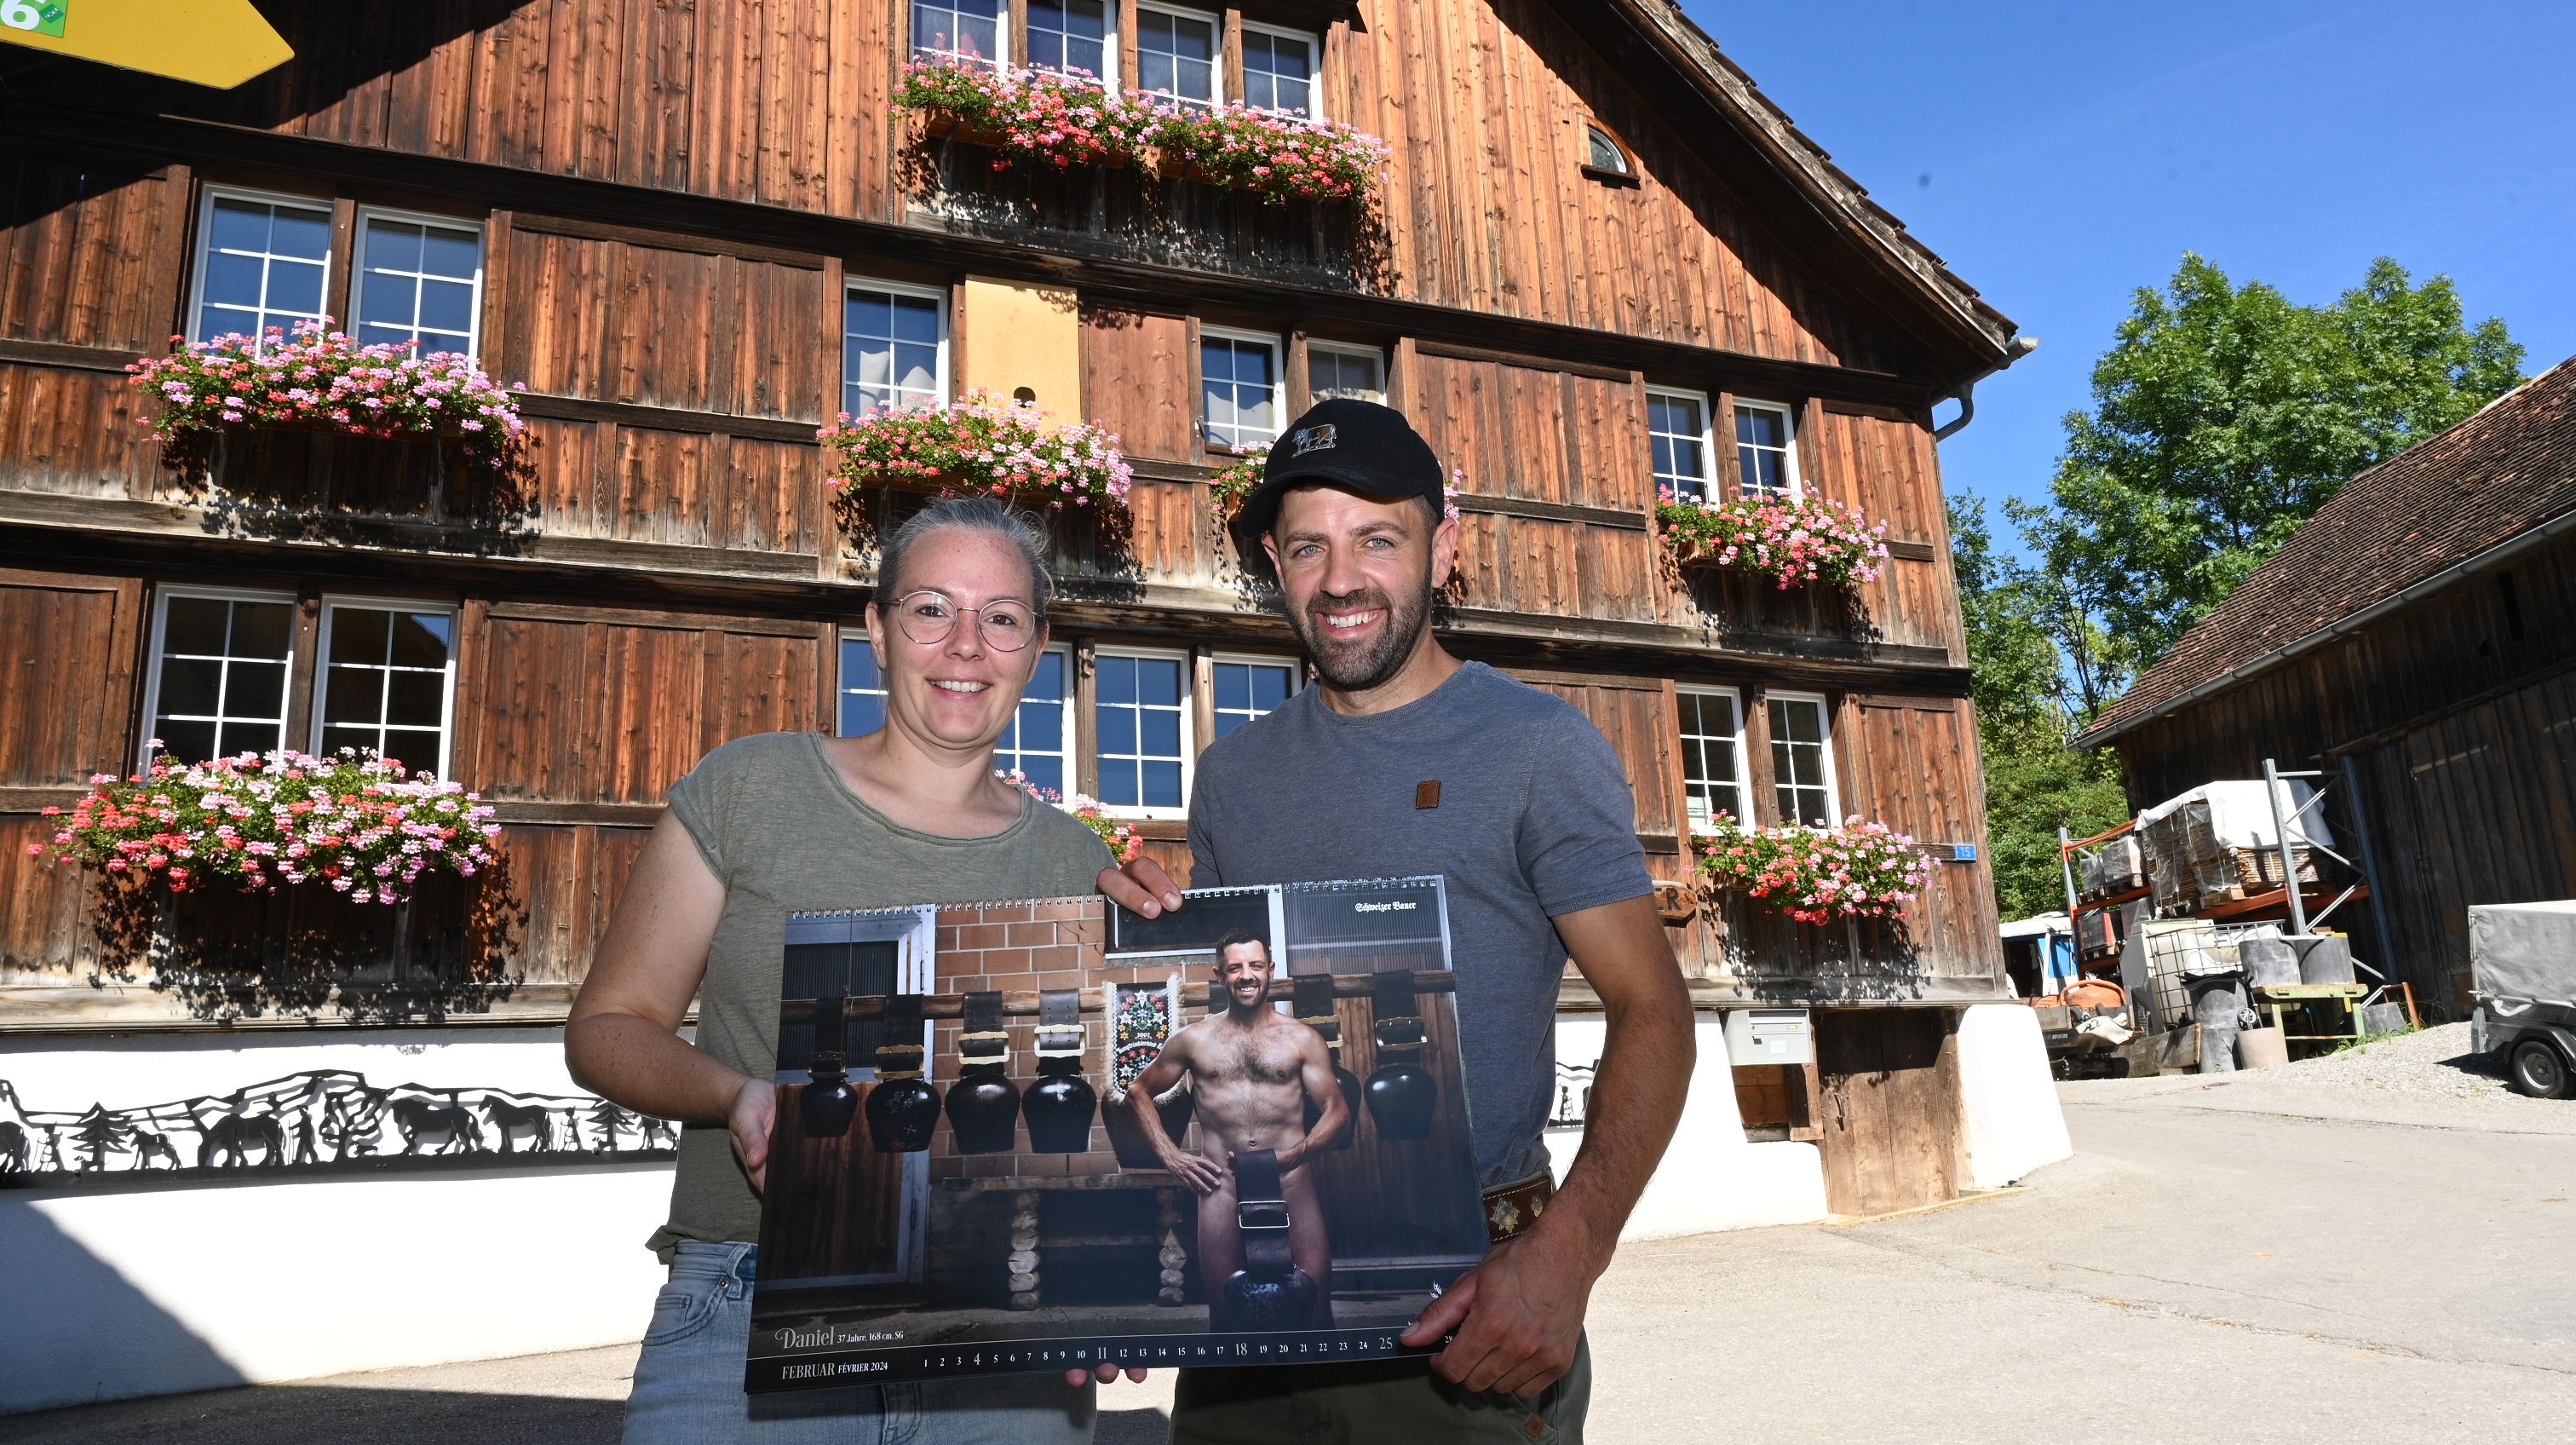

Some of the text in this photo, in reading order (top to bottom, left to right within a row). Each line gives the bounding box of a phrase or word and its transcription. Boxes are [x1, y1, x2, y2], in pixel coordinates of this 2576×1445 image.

[1960, 846, 1971, 858] 15
[1354, 901, 1417, 912] Schweizer Bauer
[775, 1326, 835, 1350] Daniel
[837, 1334, 846, 1344] 37
[869, 1332, 882, 1341] 168
[894, 1330, 904, 1339] SG
[924, 1359, 928, 1367] 1
[940, 1357, 945, 1367] 2
[957, 1356, 962, 1365] 3
[974, 1352, 980, 1365] 4
[993, 1355, 998, 1363] 5
[1026, 1352, 1032, 1361] 7
[1043, 1351, 1049, 1361] 8
[1060, 1350, 1066, 1359] 9
[1077, 1350, 1086, 1358] 10
[1098, 1346, 1107, 1360] 11
[1119, 1349, 1128, 1357] 12
[1139, 1348, 1147, 1356] 13
[1159, 1348, 1167, 1356] 14
[1178, 1347, 1186, 1356] 15
[1197, 1346, 1205, 1356] 16
[1216, 1346, 1224, 1355] 17
[1235, 1343, 1248, 1356] 18
[1259, 1344, 1268, 1353] 19
[1279, 1344, 1289, 1353] 20
[1300, 1344, 1308, 1352] 21
[1319, 1343, 1328, 1351] 22
[1338, 1342, 1348, 1350] 23
[1359, 1341, 1368, 1350] 24
[1379, 1337, 1393, 1350] 25
[781, 1362, 888, 1379] FEBRUAR FÉVRIER 2024
